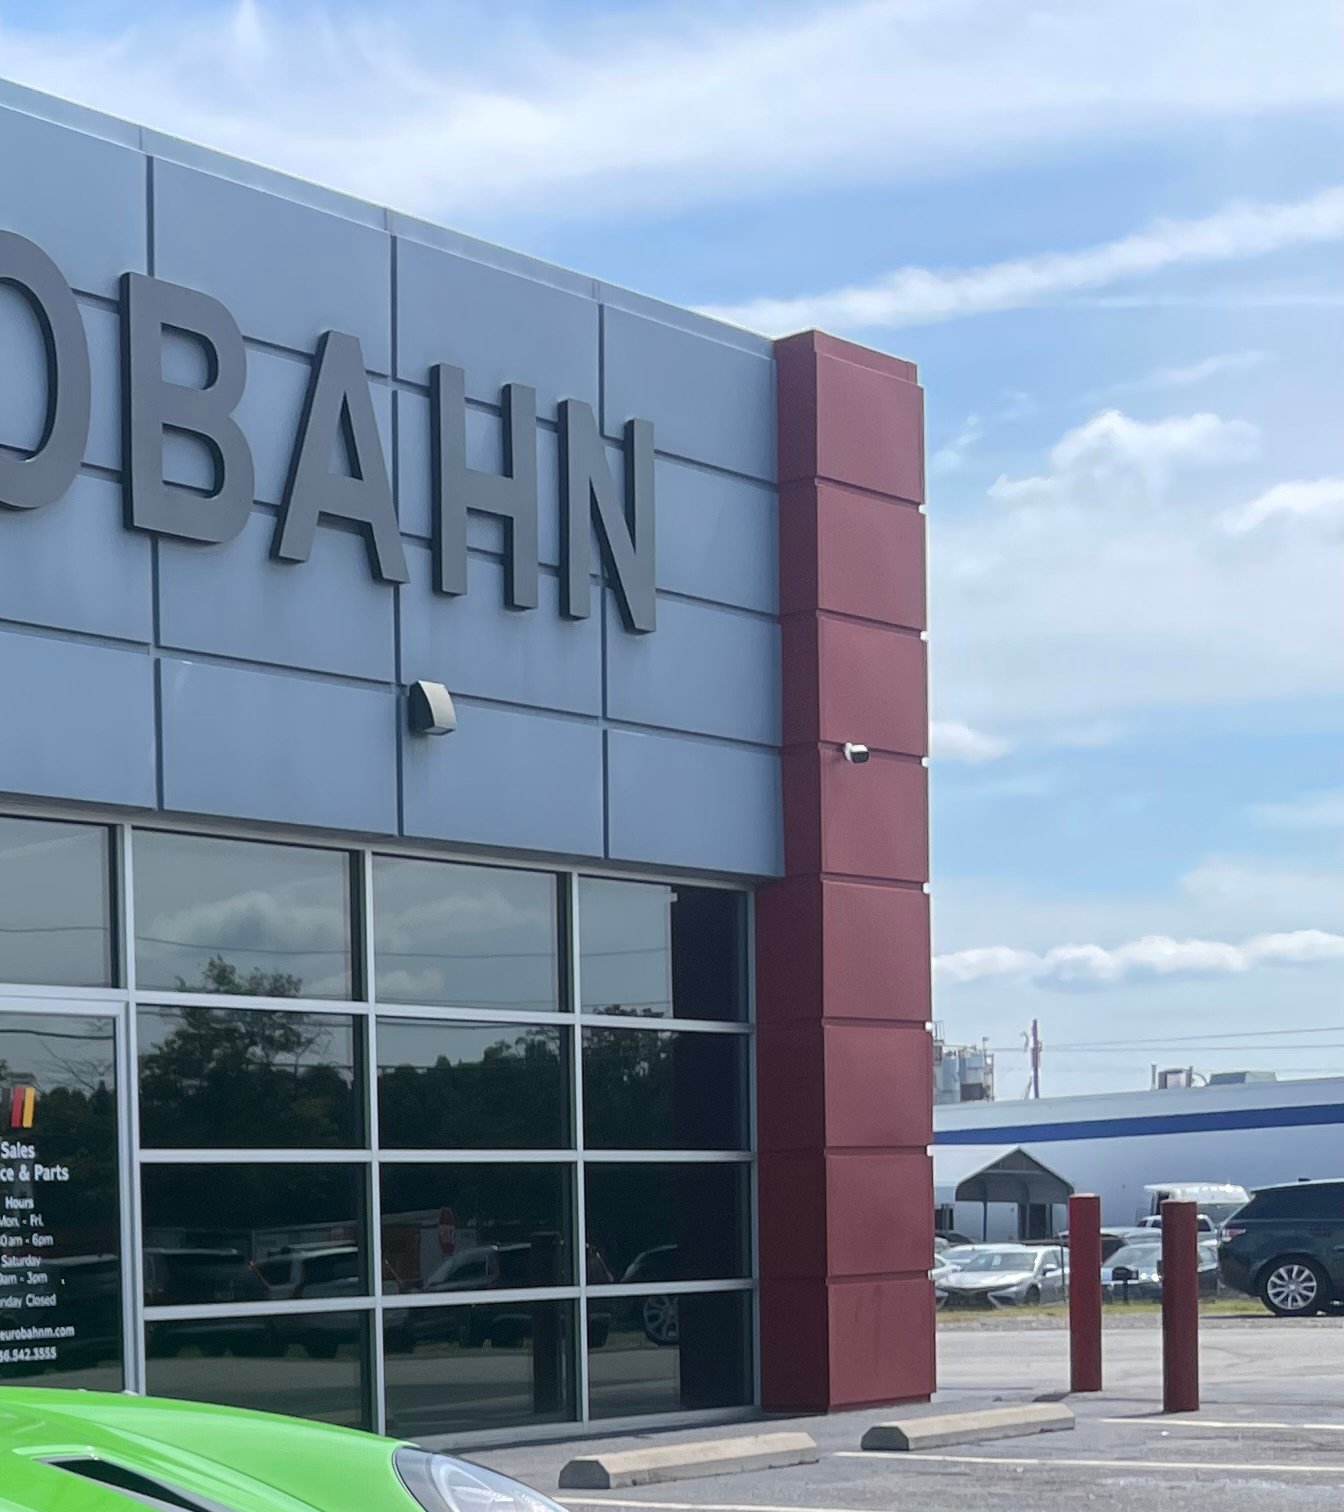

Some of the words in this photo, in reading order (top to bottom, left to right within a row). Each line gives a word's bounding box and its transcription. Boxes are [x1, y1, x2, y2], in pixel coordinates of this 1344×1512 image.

[0, 1141, 36, 1159] Sales
[19, 1163, 30, 1181] &
[34, 1163, 70, 1181] Parts
[5, 1196, 34, 1209] Hours
[1, 1254, 41, 1268] Saturday
[26, 1293, 57, 1308] Closed
